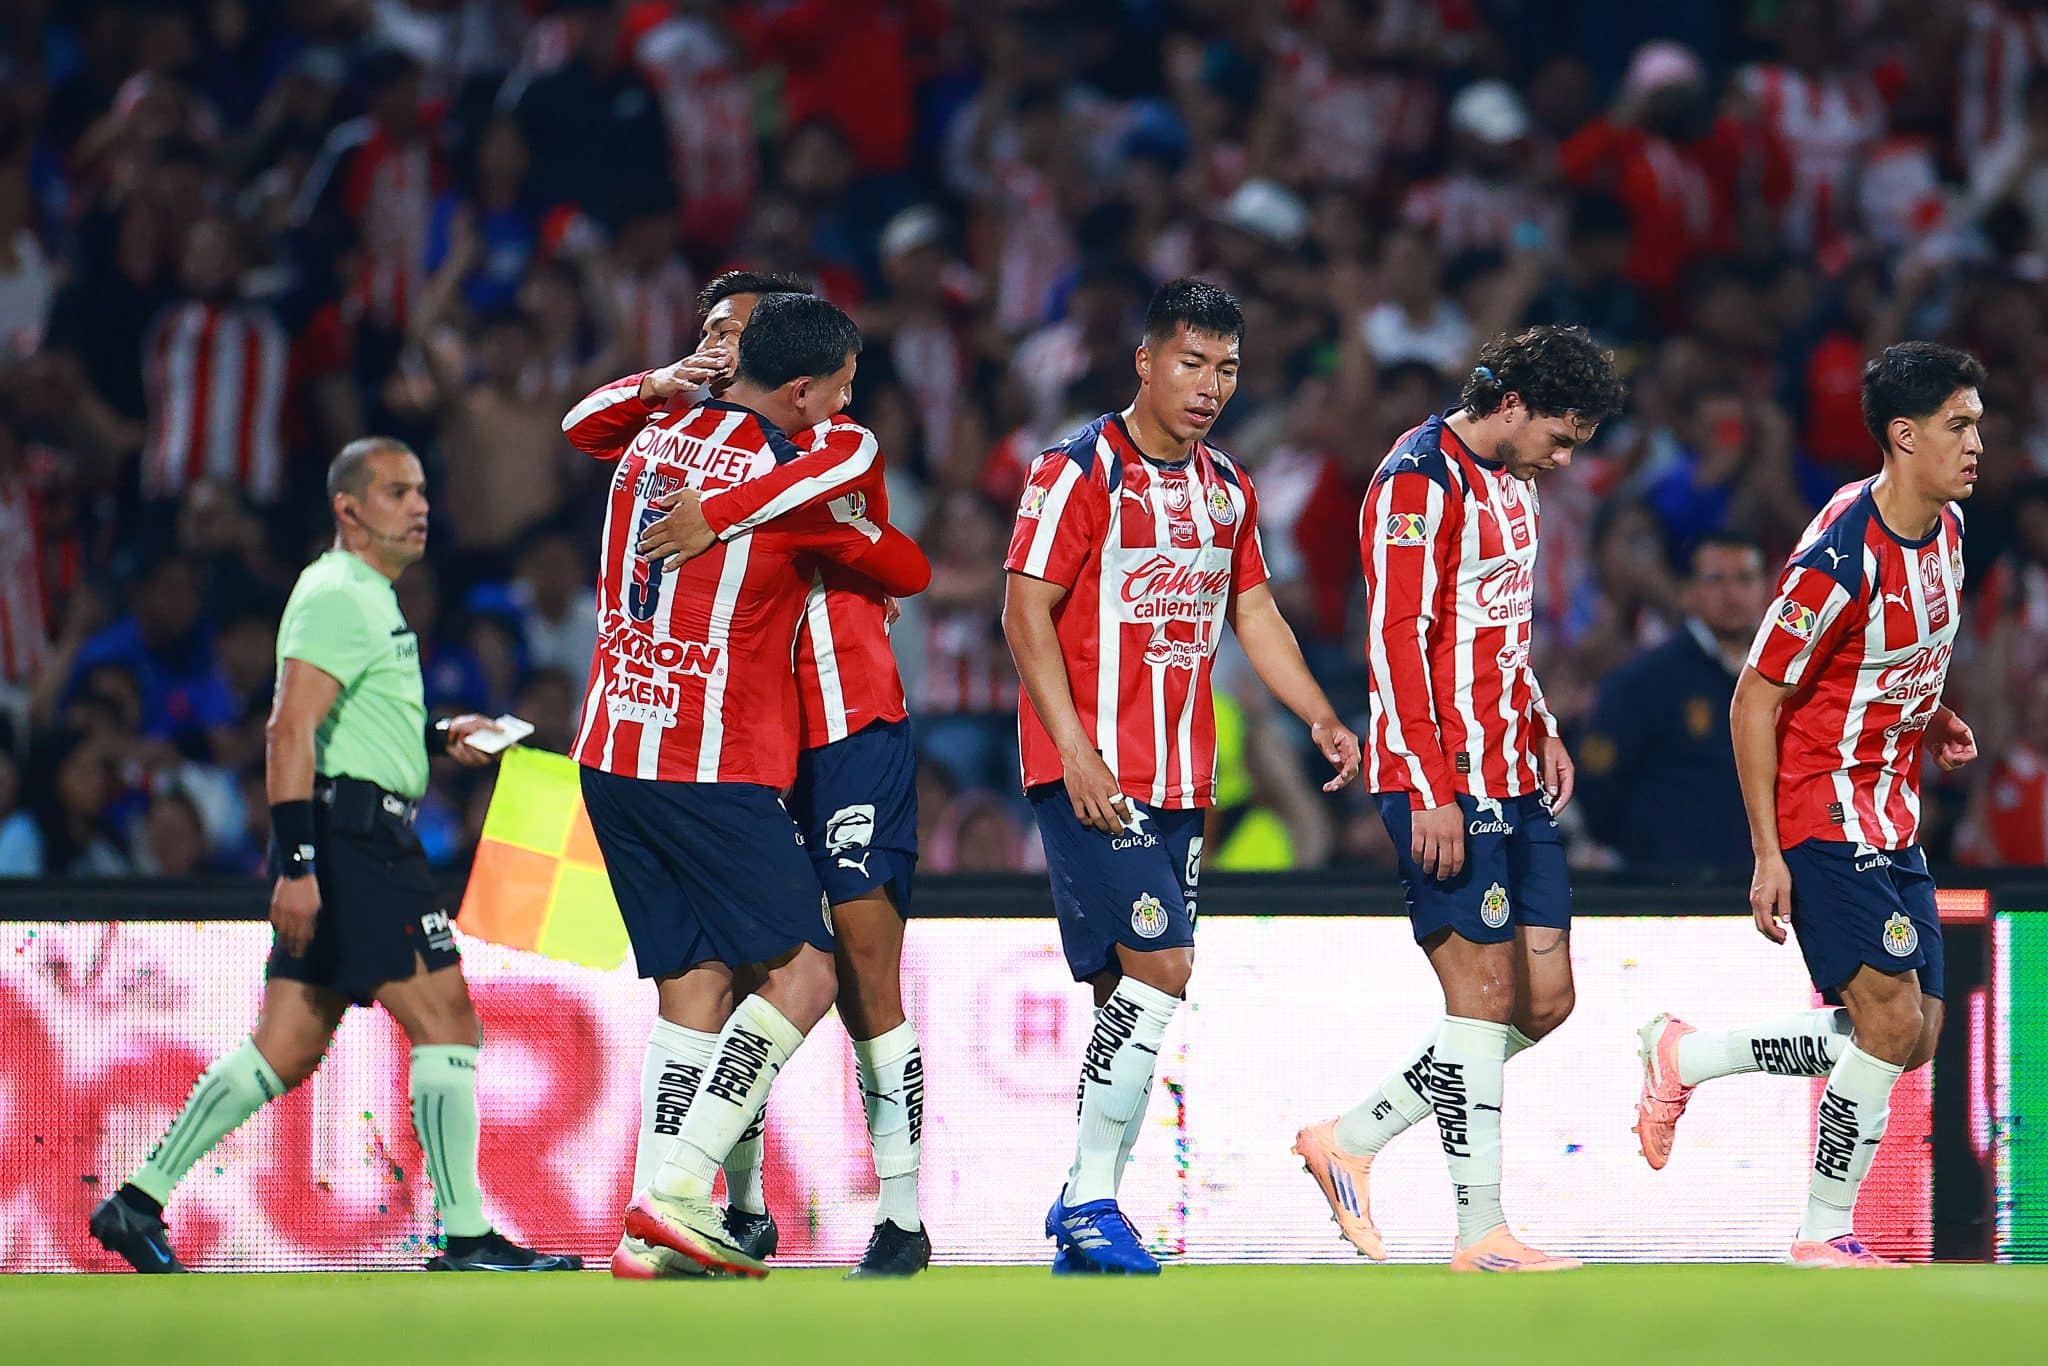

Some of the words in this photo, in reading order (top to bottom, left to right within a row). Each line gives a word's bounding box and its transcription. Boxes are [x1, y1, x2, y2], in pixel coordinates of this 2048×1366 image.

[636, 429, 747, 479] OMNILIFE
[1121, 554, 1231, 603] Caliente
[606, 702, 673, 723] APITAL
[1469, 820, 1502, 835] Carl's
[1085, 993, 1145, 1086] PERDURA
[1752, 1035, 1834, 1076] PERDURA
[705, 1026, 774, 1108] PERDURA
[654, 1062, 704, 1137] PERDURA
[1371, 1099, 1393, 1121] ALR
[1430, 1062, 1471, 1158] PERDURA
[1814, 1089, 1859, 1183] PERDURA
[1457, 1184, 1469, 1206] ALR
